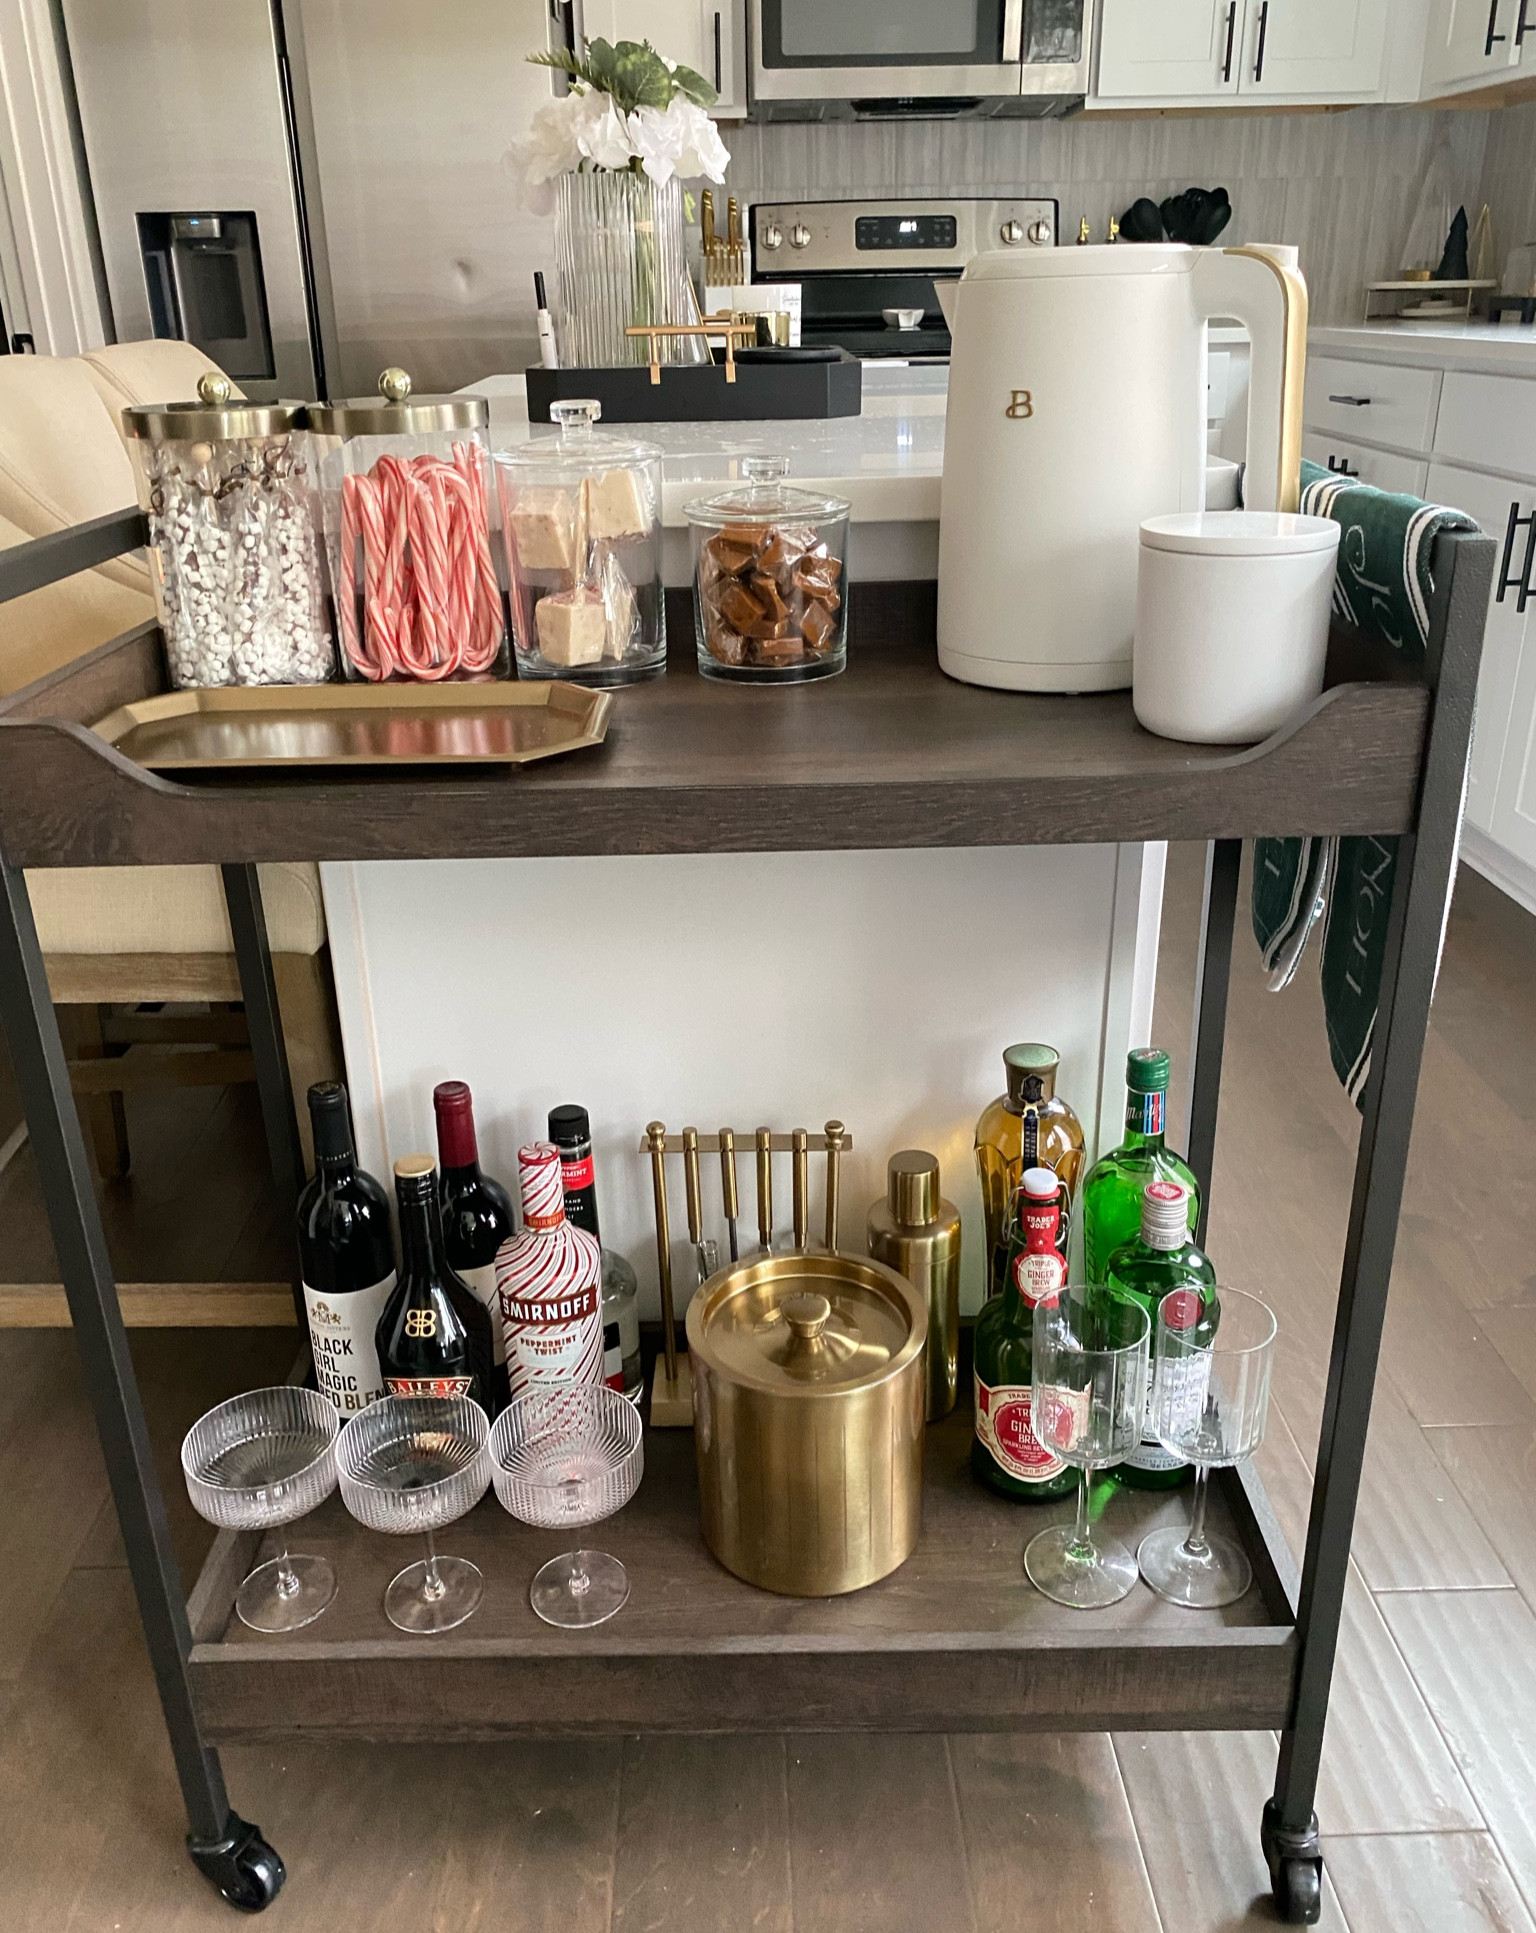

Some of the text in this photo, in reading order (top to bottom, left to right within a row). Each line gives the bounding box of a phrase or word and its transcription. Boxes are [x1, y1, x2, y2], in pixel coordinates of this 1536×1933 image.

[1006, 390, 1033, 419] B
[1027, 1270, 1055, 1279] GINGER
[502, 1293, 590, 1320] SMIRNOFF
[311, 1330, 353, 1355] BLACK
[520, 1334, 577, 1348] PEPPERMINT
[534, 1347, 563, 1355] TWIST
[314, 1349, 340, 1373] GIRL
[317, 1368, 357, 1392] MAGIC
[387, 1381, 465, 1394] BAILEYS
[1018, 1435, 1038, 1444] BRE
